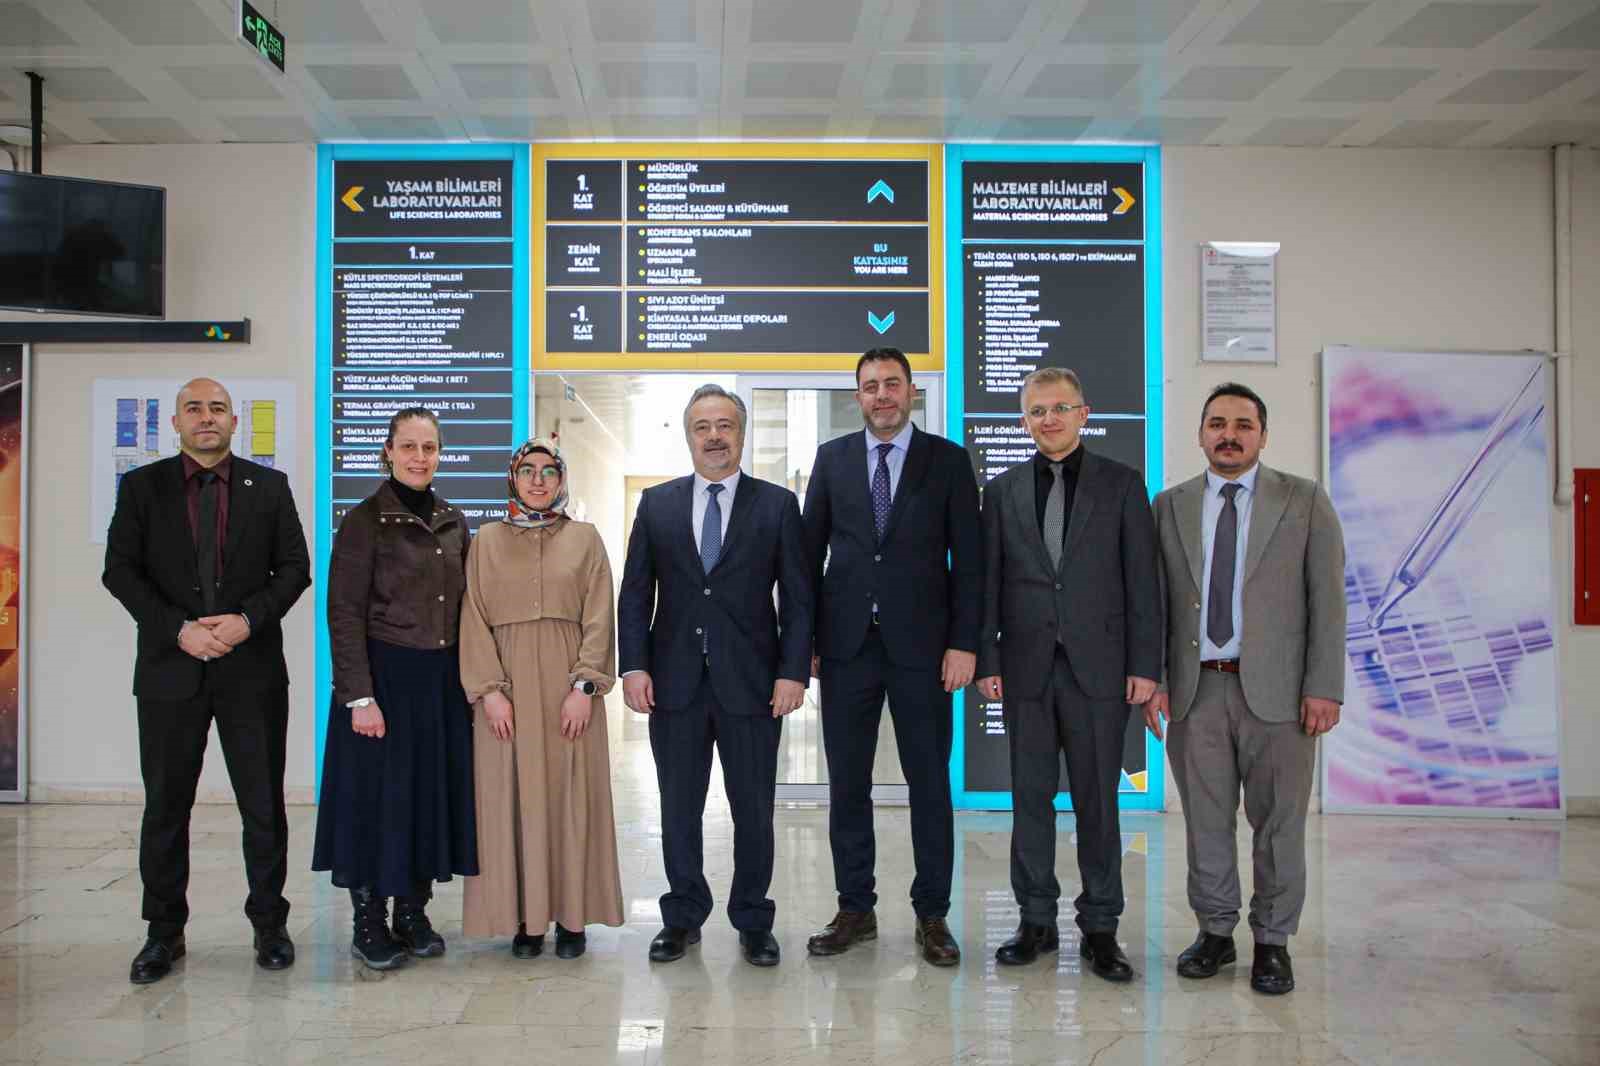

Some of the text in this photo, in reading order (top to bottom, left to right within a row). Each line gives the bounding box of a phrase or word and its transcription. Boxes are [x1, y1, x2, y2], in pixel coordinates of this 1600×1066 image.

[648, 163, 698, 172] MÜDÜRLÜK
[387, 178, 502, 196] YAŞAM BİLİMLERİ
[577, 175, 589, 191] 1.
[648, 183, 725, 192] ÖĞRETİM ÜYELERİ
[973, 180, 1107, 195] MALZEME BİLİMLERİ
[373, 196, 502, 207] LABORATUVARLARI
[574, 194, 593, 202] KAT
[648, 203, 688, 212] ÖĞRENCİ
[735, 203, 789, 213] KÜTÜPHANE
[973, 198, 1102, 210] LABORATUVARLARI
[973, 213, 1108, 221] MATERIAL SCIENCES LABORATORIES
[409, 246, 418, 259] 1.
[568, 243, 600, 254] ZEMİN
[874, 244, 888, 252] BU
[973, 252, 995, 261] TEMİZ
[1088, 252, 1136, 261] EKİPMANLARI
[575, 258, 594, 266] KAT
[344, 272, 463, 281] KÜTLE SPEKTROSKOPİ SİSTEMLERİ
[648, 267, 695, 279] MALİ İŞLER
[690, 295, 724, 304] ÜNİTESİ
[648, 314, 690, 323] KİMYASAL
[574, 325, 593, 333] KAT
[648, 332, 677, 340] ENERJİ
[391, 375, 418, 385] ÖLÇÜM
[974, 426, 992, 434] İLERİ
